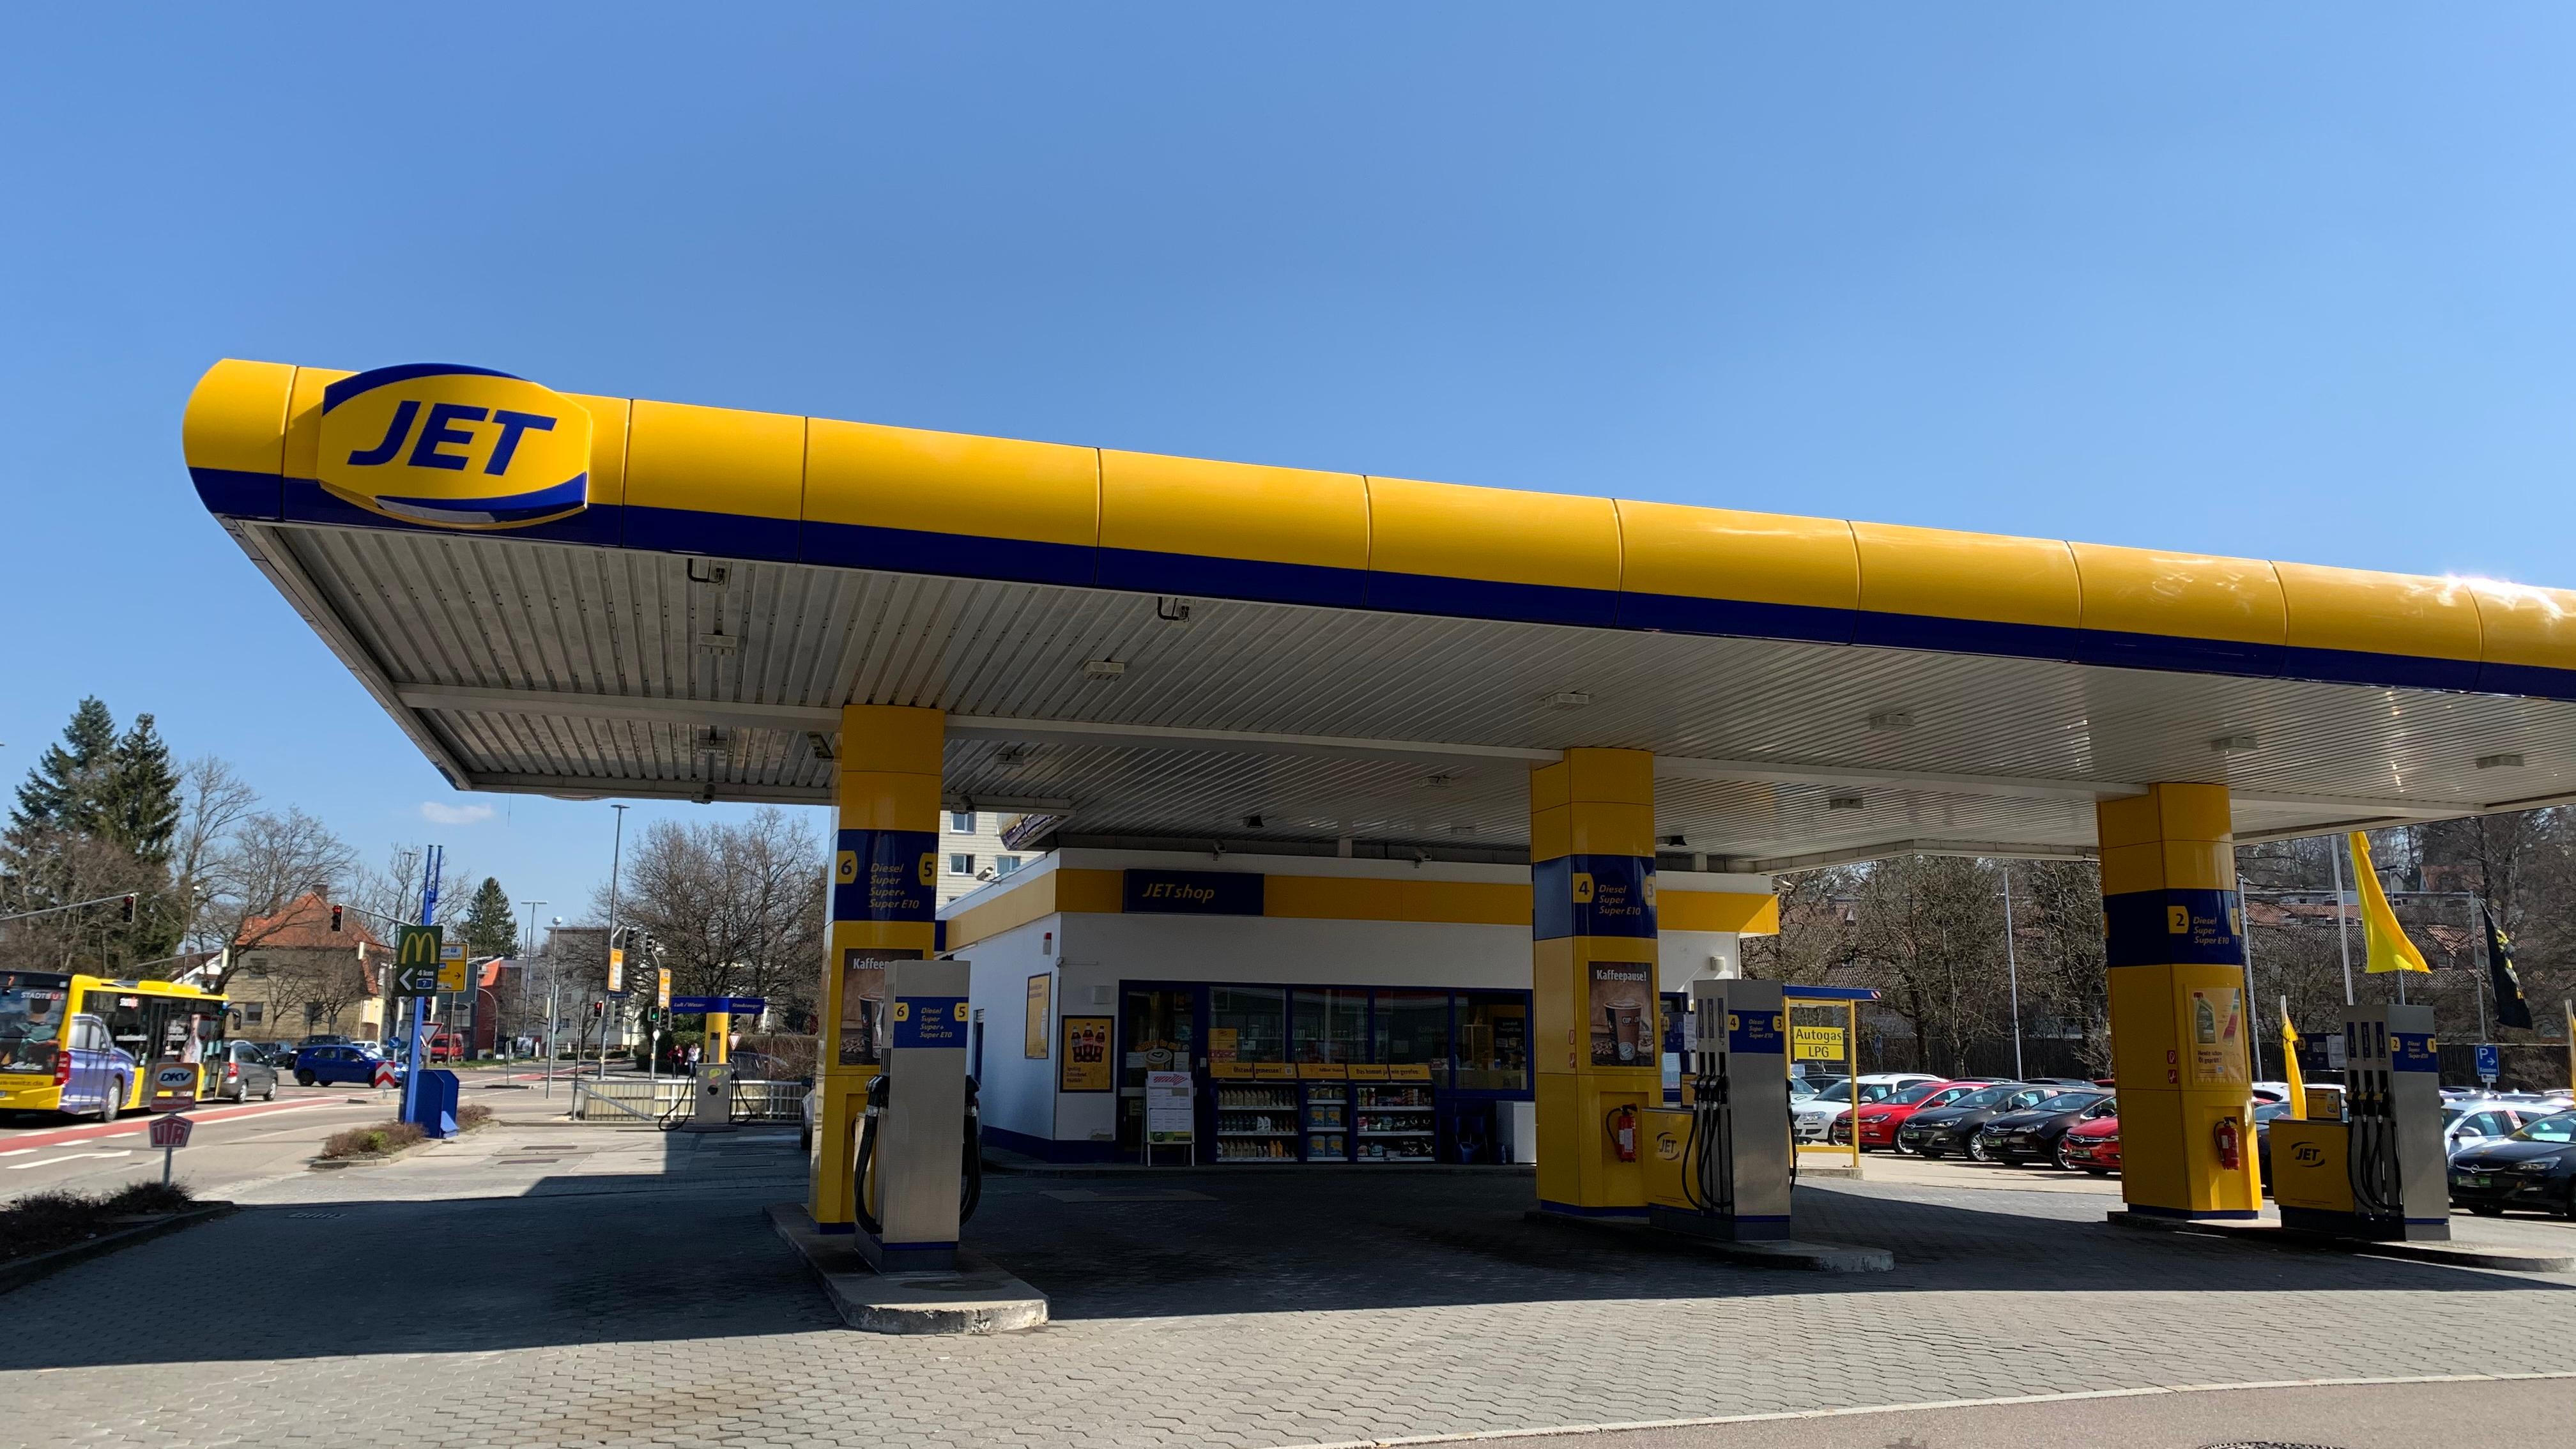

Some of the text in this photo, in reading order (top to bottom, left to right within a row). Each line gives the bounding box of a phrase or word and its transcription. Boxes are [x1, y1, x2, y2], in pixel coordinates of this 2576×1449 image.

[348, 400, 557, 476] JET
[841, 859, 852, 875] 6
[870, 862, 905, 873] Diesel
[924, 862, 933, 877] 5
[870, 875, 901, 887] Super
[868, 887, 905, 898] Super+
[1578, 881, 1590, 895] 4
[1598, 884, 1627, 894] Diesel
[1646, 883, 1653, 897] 3
[868, 898, 920, 911] Super E10
[1598, 895, 1625, 906] Super
[1598, 906, 1641, 916] Super E10
[2175, 913, 2185, 926] 2
[2193, 916, 2217, 925] Diesel
[2193, 926, 2216, 937] Super
[2193, 936, 2217, 946] Super
[853, 957, 890, 970] Kaffee
[1597, 969, 1647, 983] Kaffeepause!
[20, 992, 65, 1000] STADTBUS
[896, 1005, 905, 1017] 6
[959, 1006, 965, 1018] 5
[920, 1015, 941, 1023] Super
[1729, 1018, 1736, 1028] 4
[1776, 1019, 1782, 1028] 3
[919, 1031, 939, 1039] Super
[1795, 1028, 1842, 1043] Autogas
[2393, 1039, 2398, 1049] 2
[2430, 1041, 2434, 1050] 1
[1808, 1045, 1829, 1058] LPG
[2480, 1048, 2489, 1060] P
[159, 1072, 191, 1082] DKV
[152, 1123, 187, 1146] UTA
[1659, 1138, 1677, 1153] JET
[2295, 1148, 2321, 1161] JET
